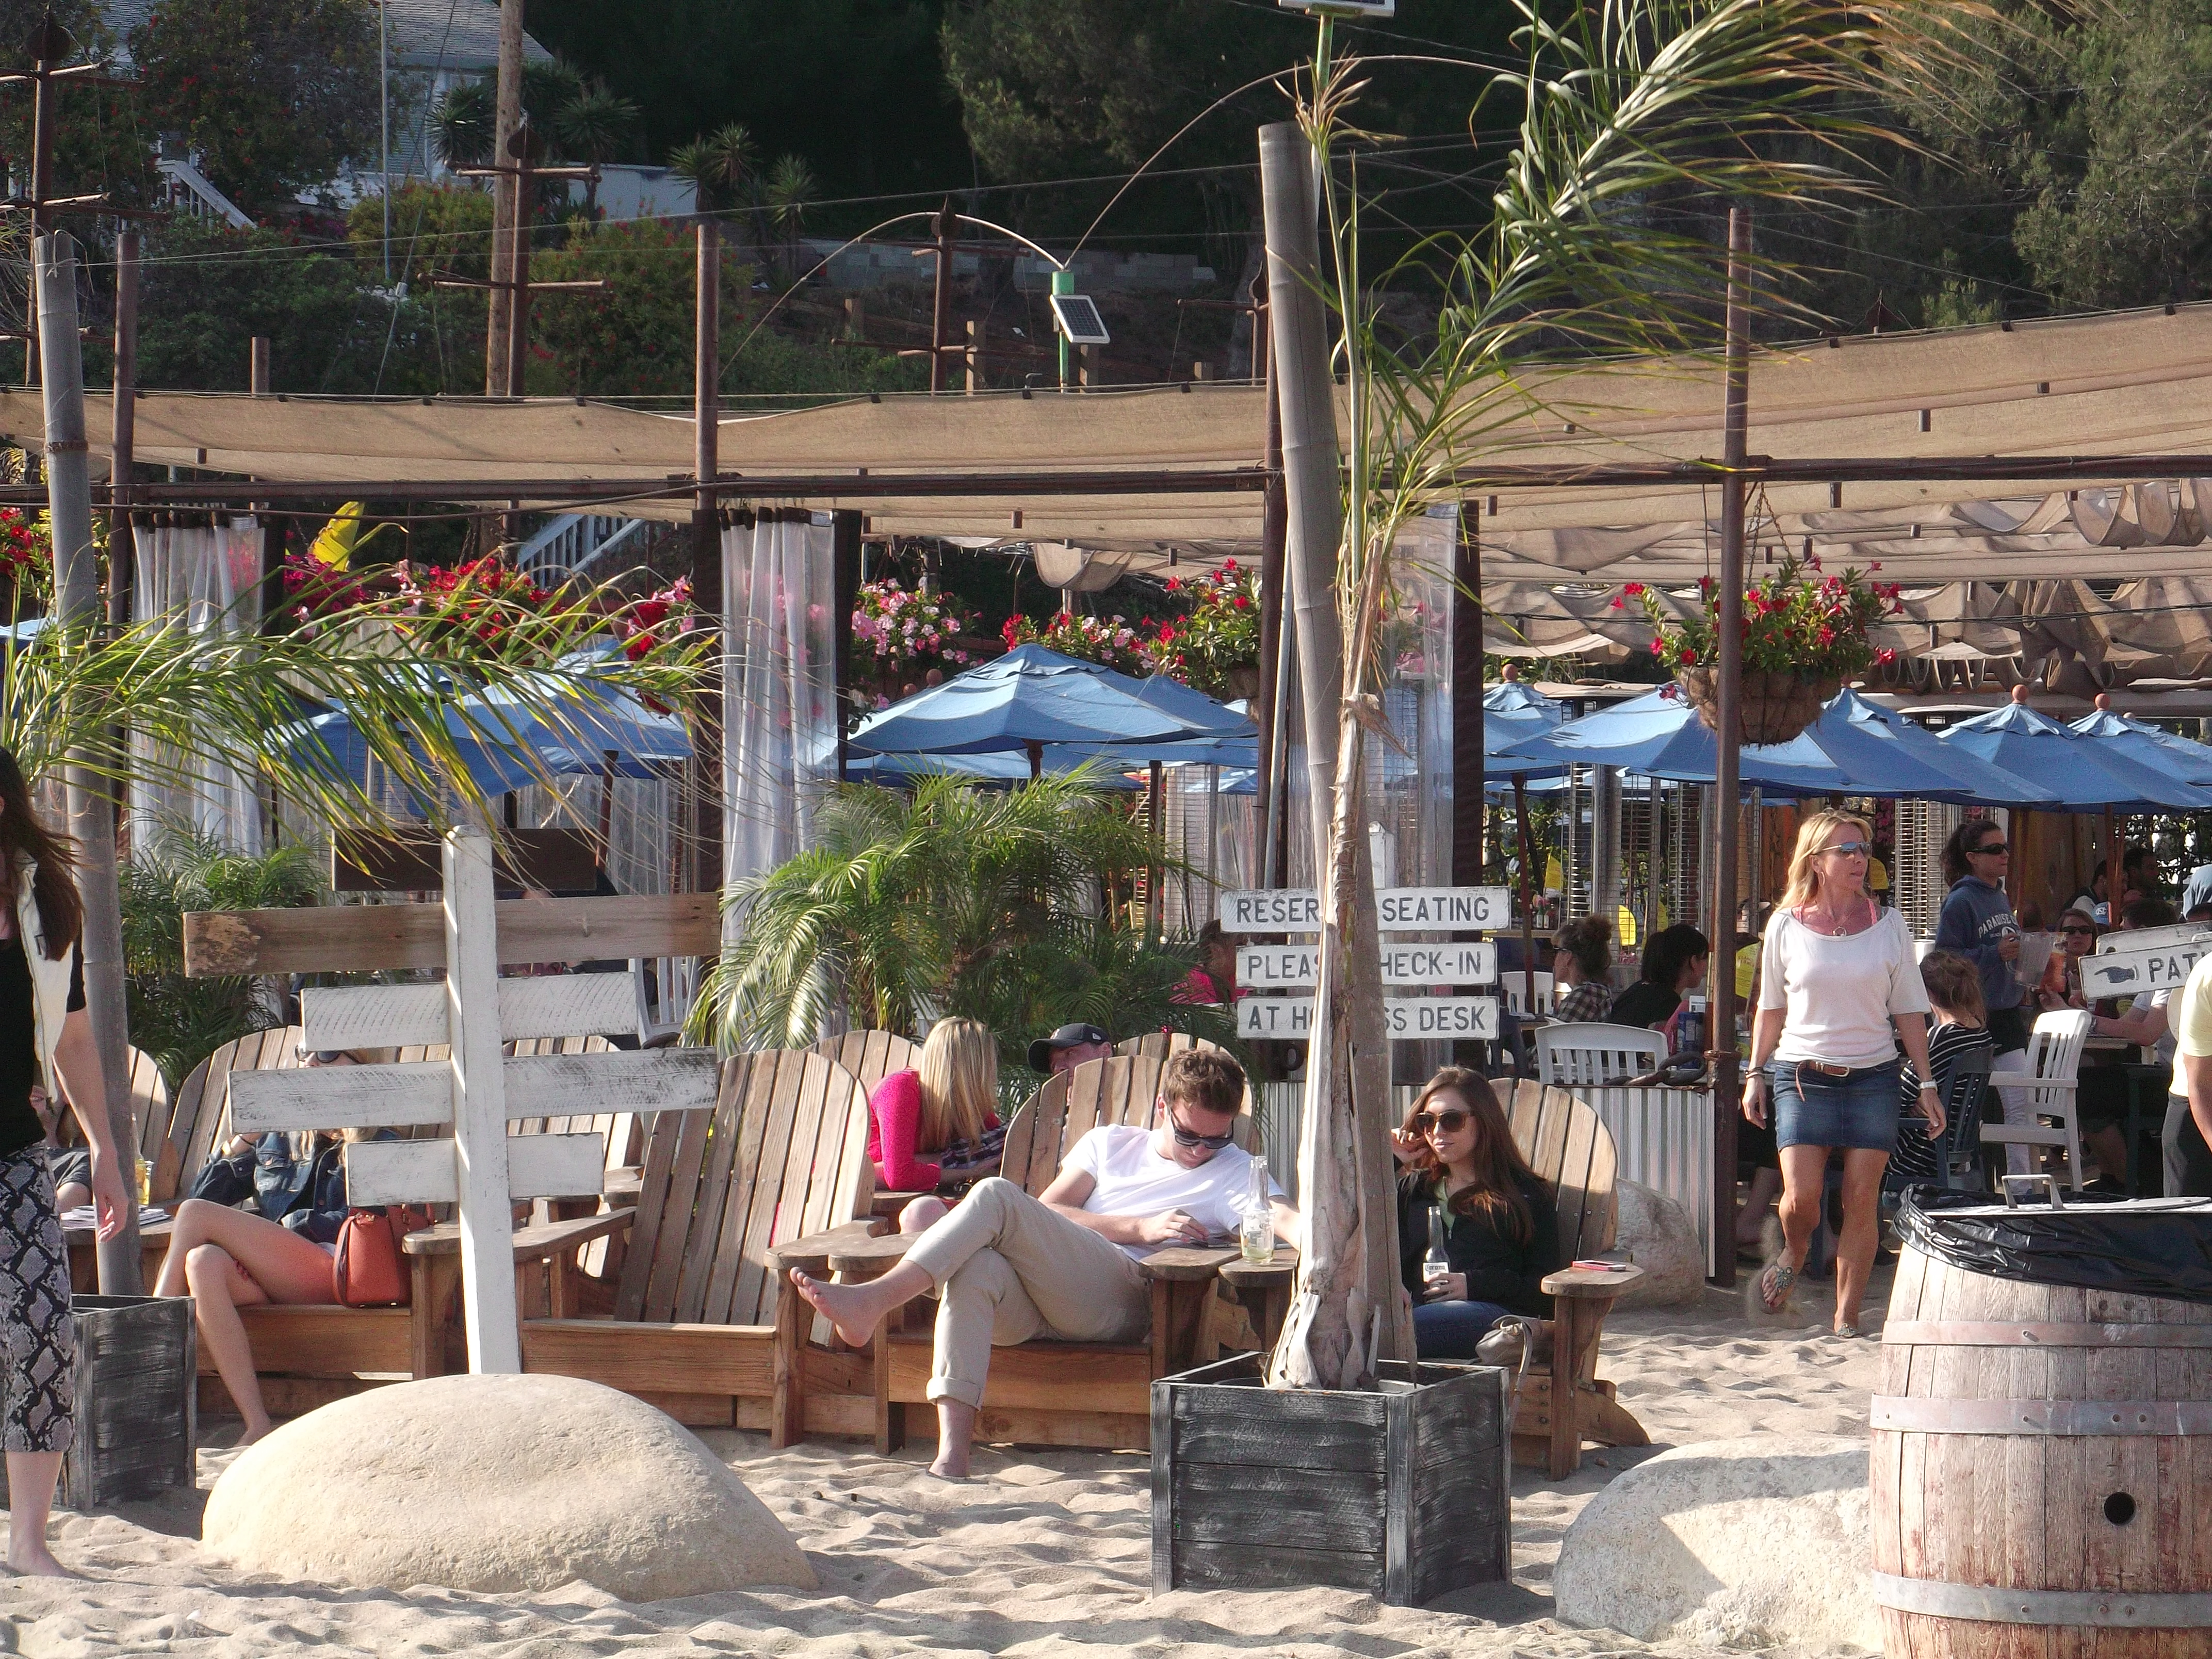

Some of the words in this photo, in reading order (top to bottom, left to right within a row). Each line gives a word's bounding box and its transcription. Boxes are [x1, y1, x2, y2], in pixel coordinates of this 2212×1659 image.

[1237, 897, 1319, 923] RESER
[1382, 896, 1489, 922] SEATING
[1978, 913, 2011, 938] PARADISE
[1248, 954, 1319, 979] PLEA
[1380, 951, 1481, 977] HECK-IN
[2148, 951, 2206, 983] PAT
[1247, 1005, 1280, 1030] AT
[1420, 1006, 1486, 1031] DESK
